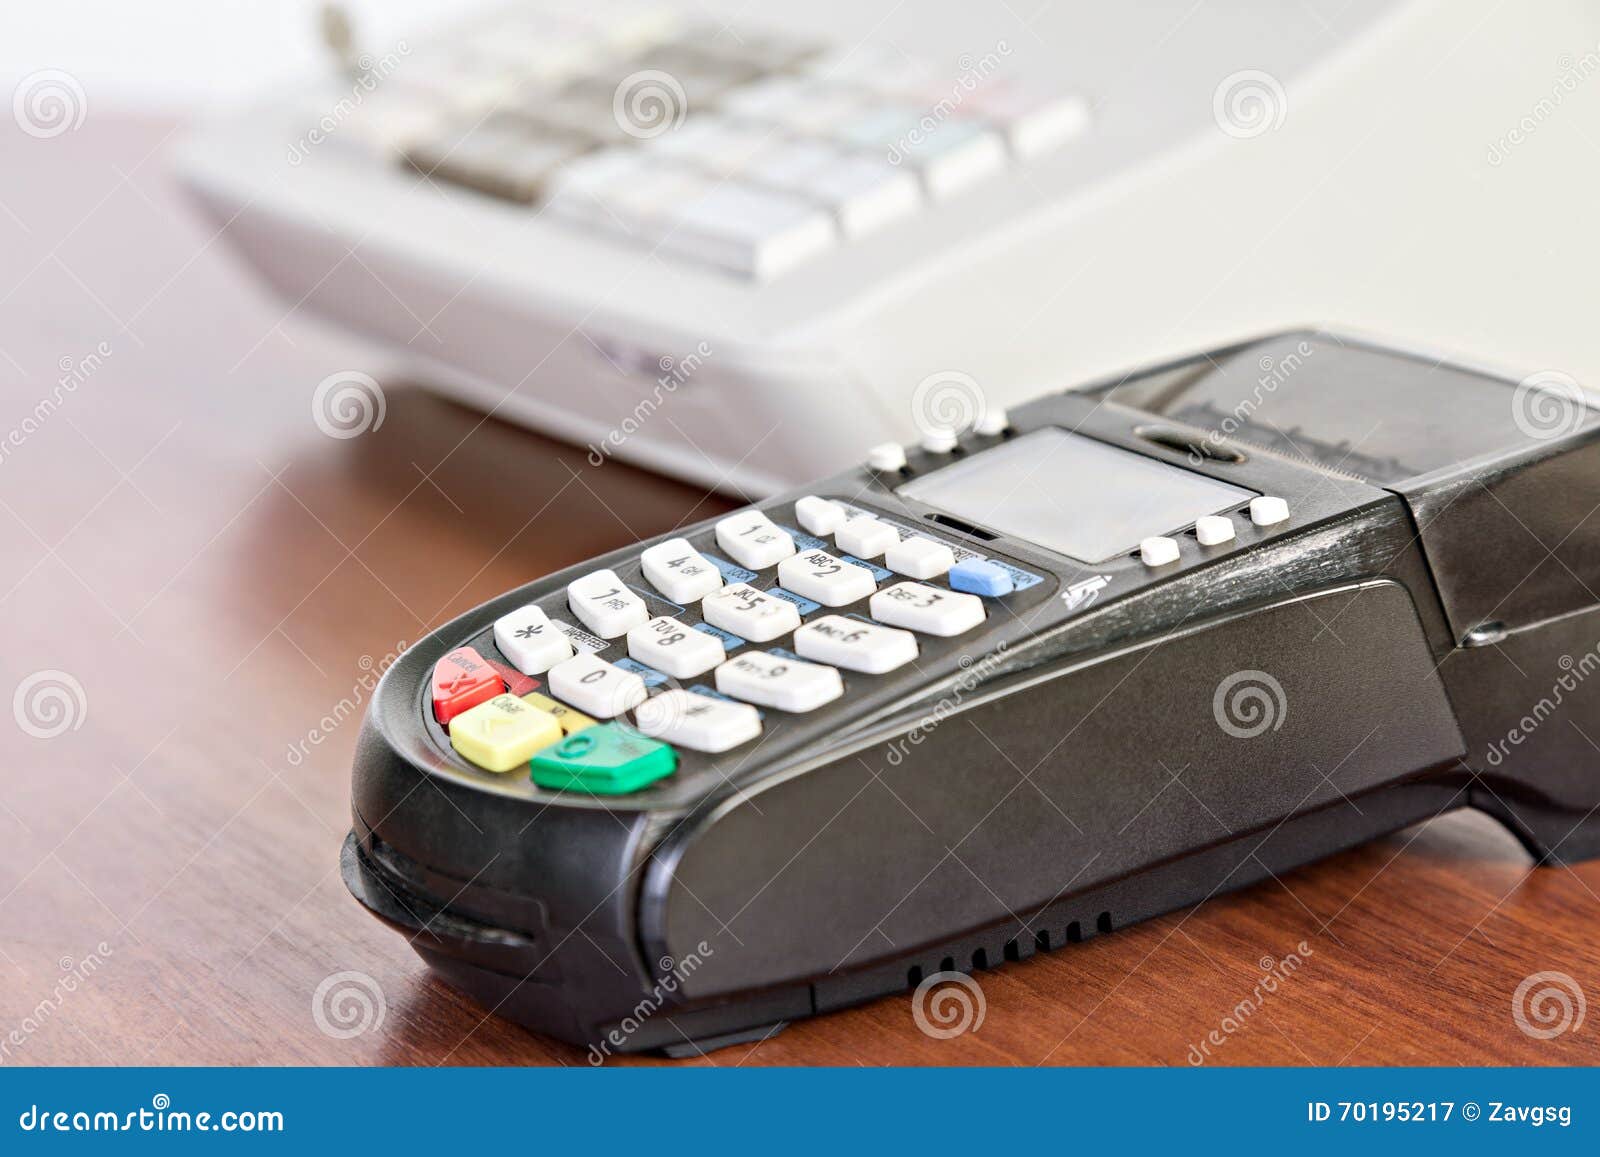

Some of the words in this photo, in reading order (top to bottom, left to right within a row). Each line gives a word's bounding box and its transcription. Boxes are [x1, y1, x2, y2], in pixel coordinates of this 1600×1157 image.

[667, 556, 690, 568] 4
[804, 553, 835, 567] ABC
[812, 565, 841, 578] 2
[591, 588, 621, 600] 7
[732, 588, 756, 601] JKL
[735, 597, 767, 611] 5
[913, 594, 944, 608] 3
[657, 633, 686, 646] 8
[842, 630, 869, 643] 6
[769, 664, 788, 677] 9
